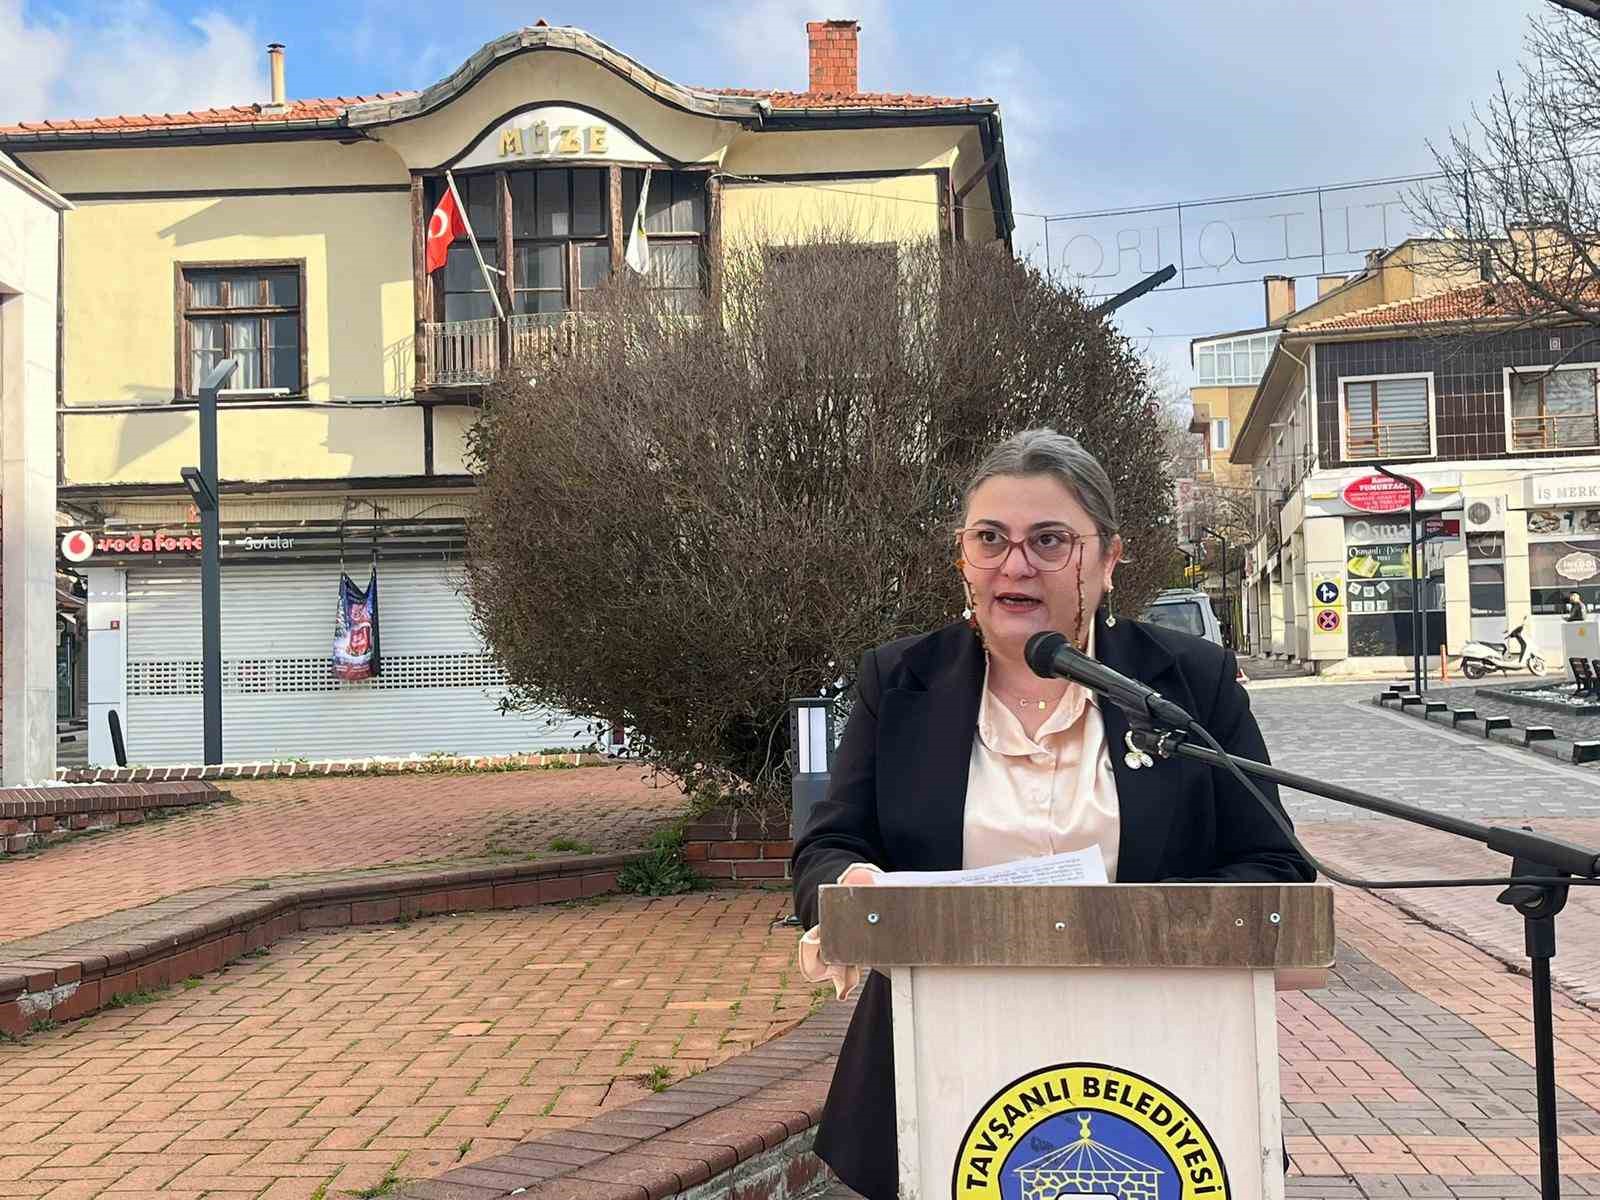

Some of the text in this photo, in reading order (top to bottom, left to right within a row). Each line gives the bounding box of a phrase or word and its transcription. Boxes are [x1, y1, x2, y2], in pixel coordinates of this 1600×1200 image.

[498, 120, 609, 157] MÜZE
[1556, 485, 1600, 498] MERK
[1352, 521, 1409, 538] Osma
[244, 536, 295, 551] Sofular
[966, 1076, 1223, 1194] TAVŞANLI BELEDİYESİ
